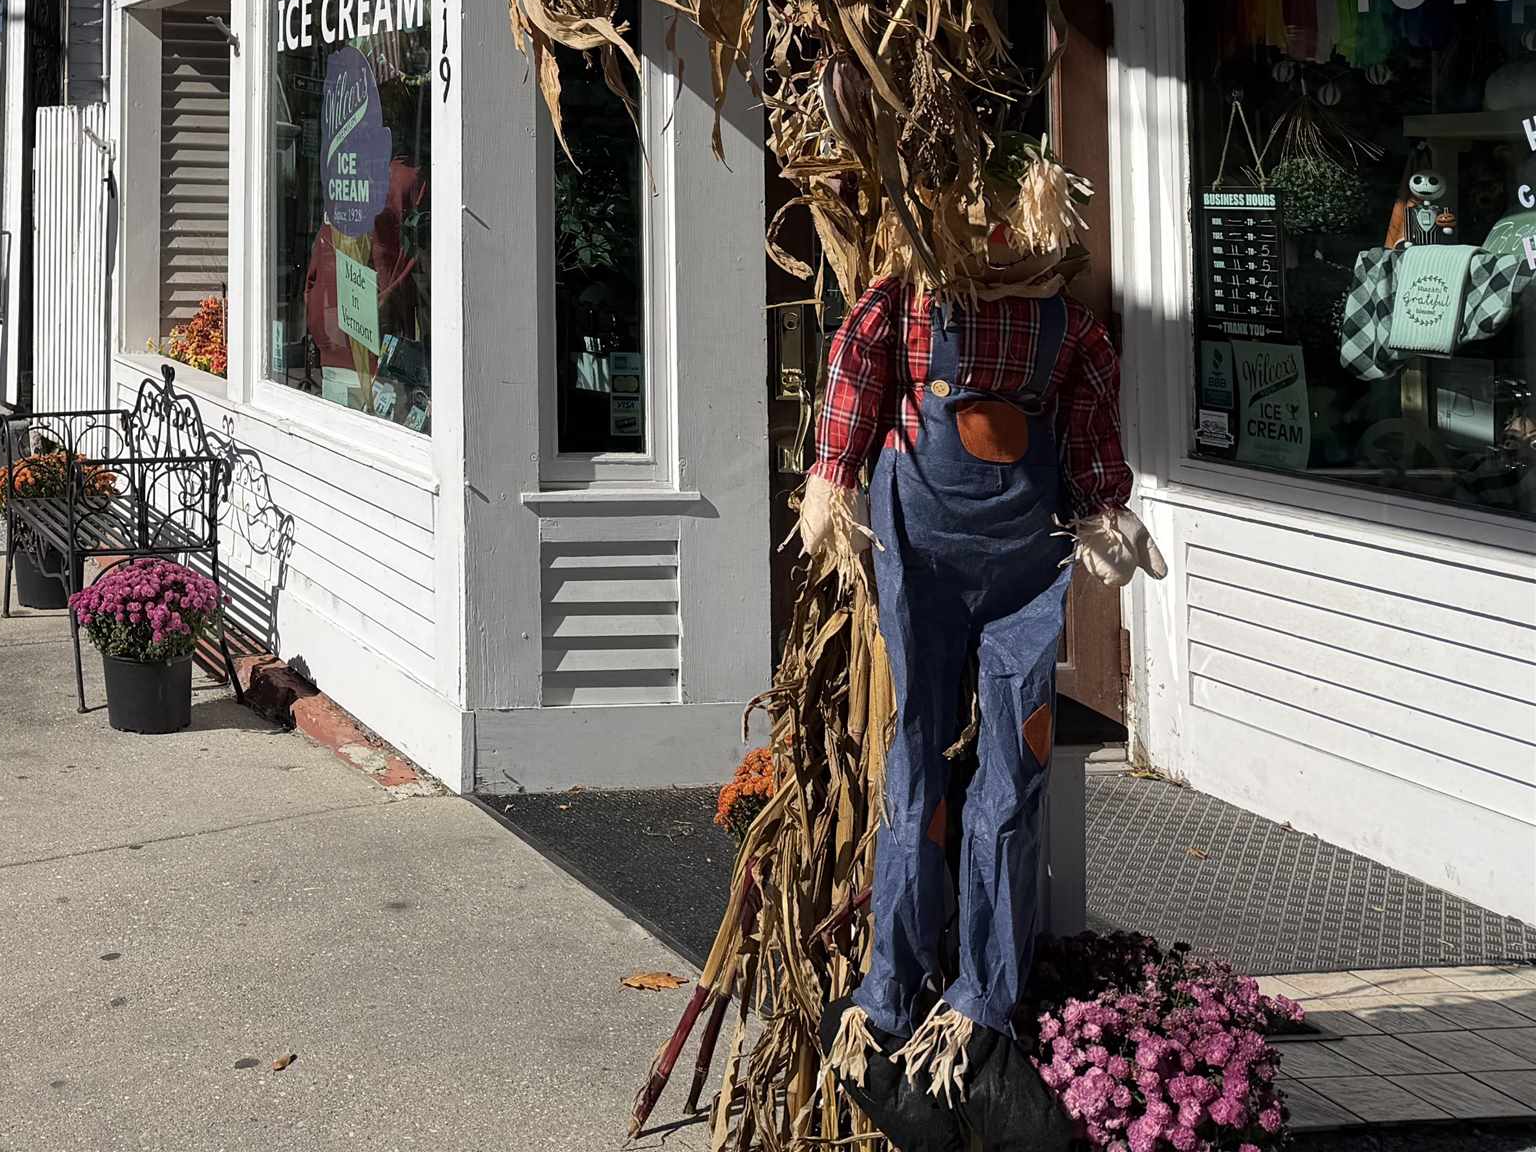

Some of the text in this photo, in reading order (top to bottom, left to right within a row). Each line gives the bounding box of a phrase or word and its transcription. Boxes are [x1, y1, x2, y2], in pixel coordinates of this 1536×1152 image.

[337, 152, 357, 175] ICE
[328, 179, 370, 203] CREAM
[1203, 192, 1276, 207] BUSINESS HOURS
[1261, 245, 1270, 257] 5
[345, 260, 366, 290] Made
[1262, 260, 1271, 272] 5
[351, 289, 360, 310] in
[1403, 291, 1450, 309] Grateful
[341, 304, 373, 343] Vermont
[1222, 321, 1265, 336] THANK YOU
[1242, 352, 1297, 393] Wilcox's
[1259, 402, 1282, 421] ICE
[1247, 419, 1303, 445] CREAM
